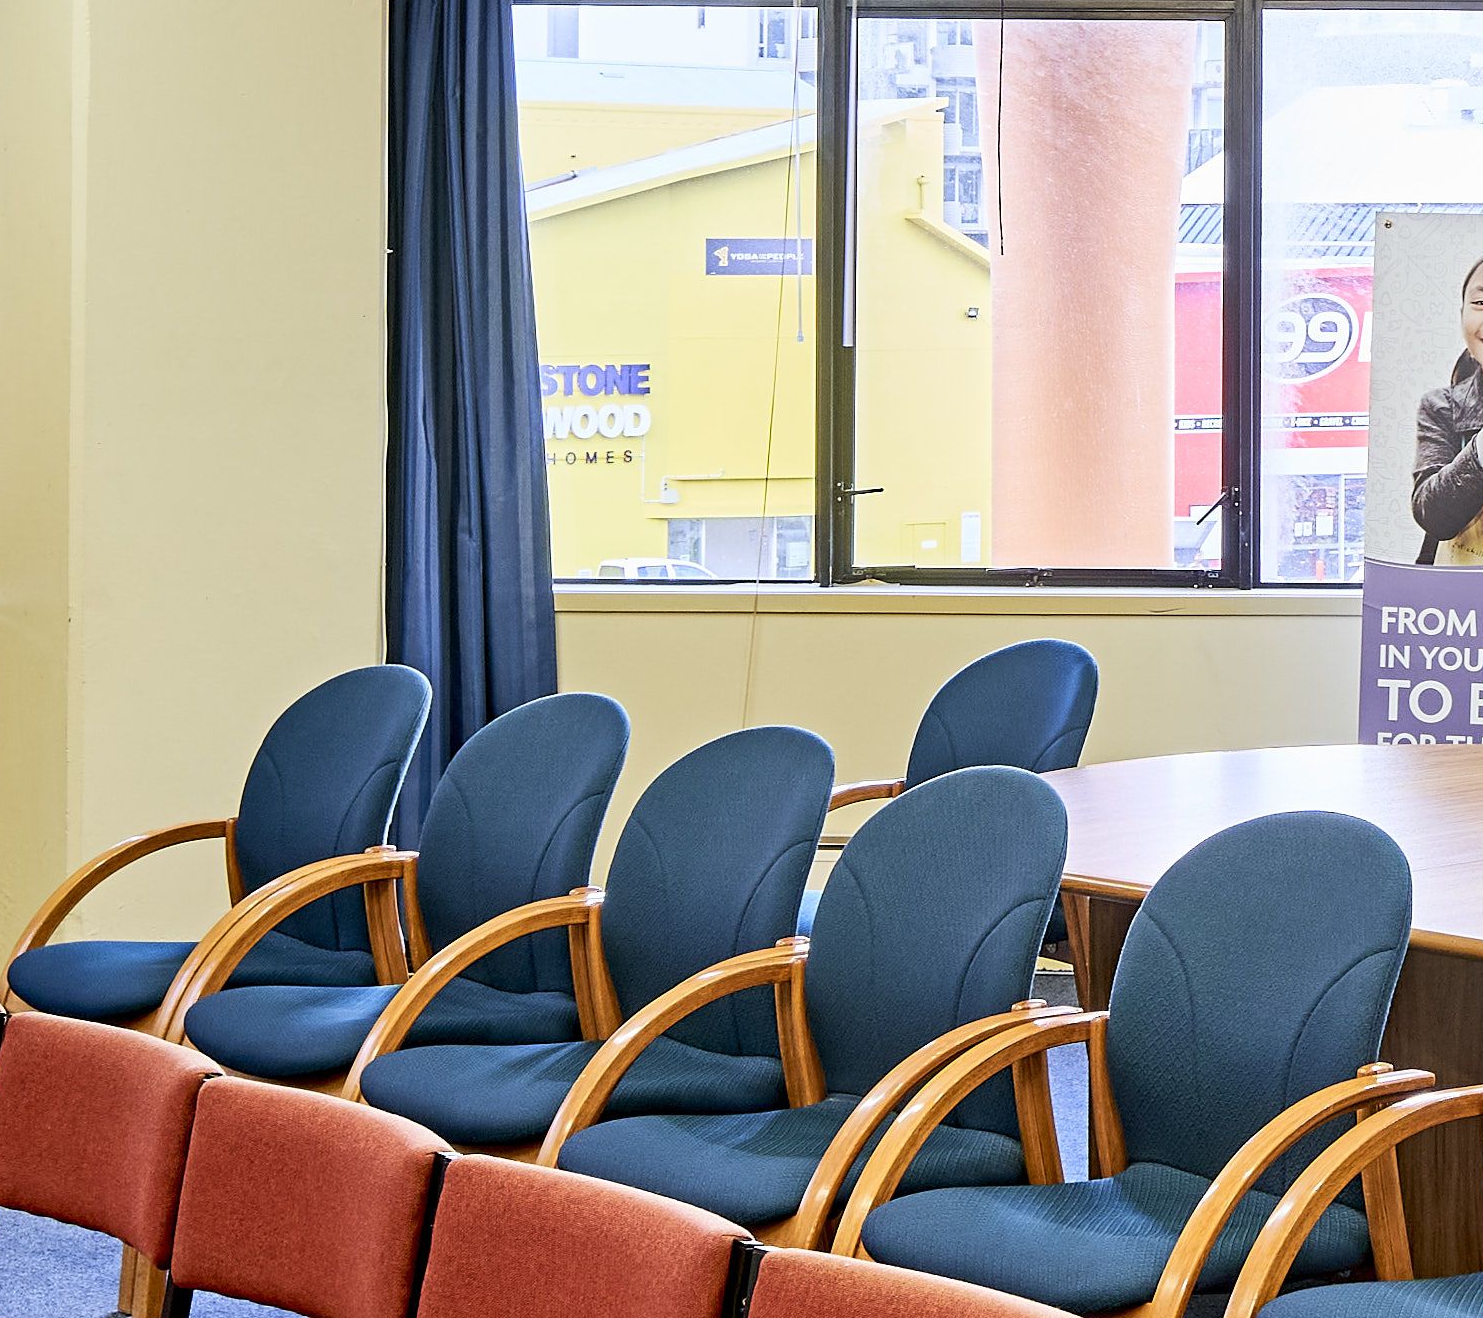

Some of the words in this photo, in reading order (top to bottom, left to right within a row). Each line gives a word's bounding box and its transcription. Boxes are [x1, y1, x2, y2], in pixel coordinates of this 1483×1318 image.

[539, 363, 651, 397] STONE
[543, 403, 652, 440] WOOD
[1381, 606, 1477, 637] FROM
[1379, 644, 1410, 669] IN
[1377, 678, 1453, 724] TO
